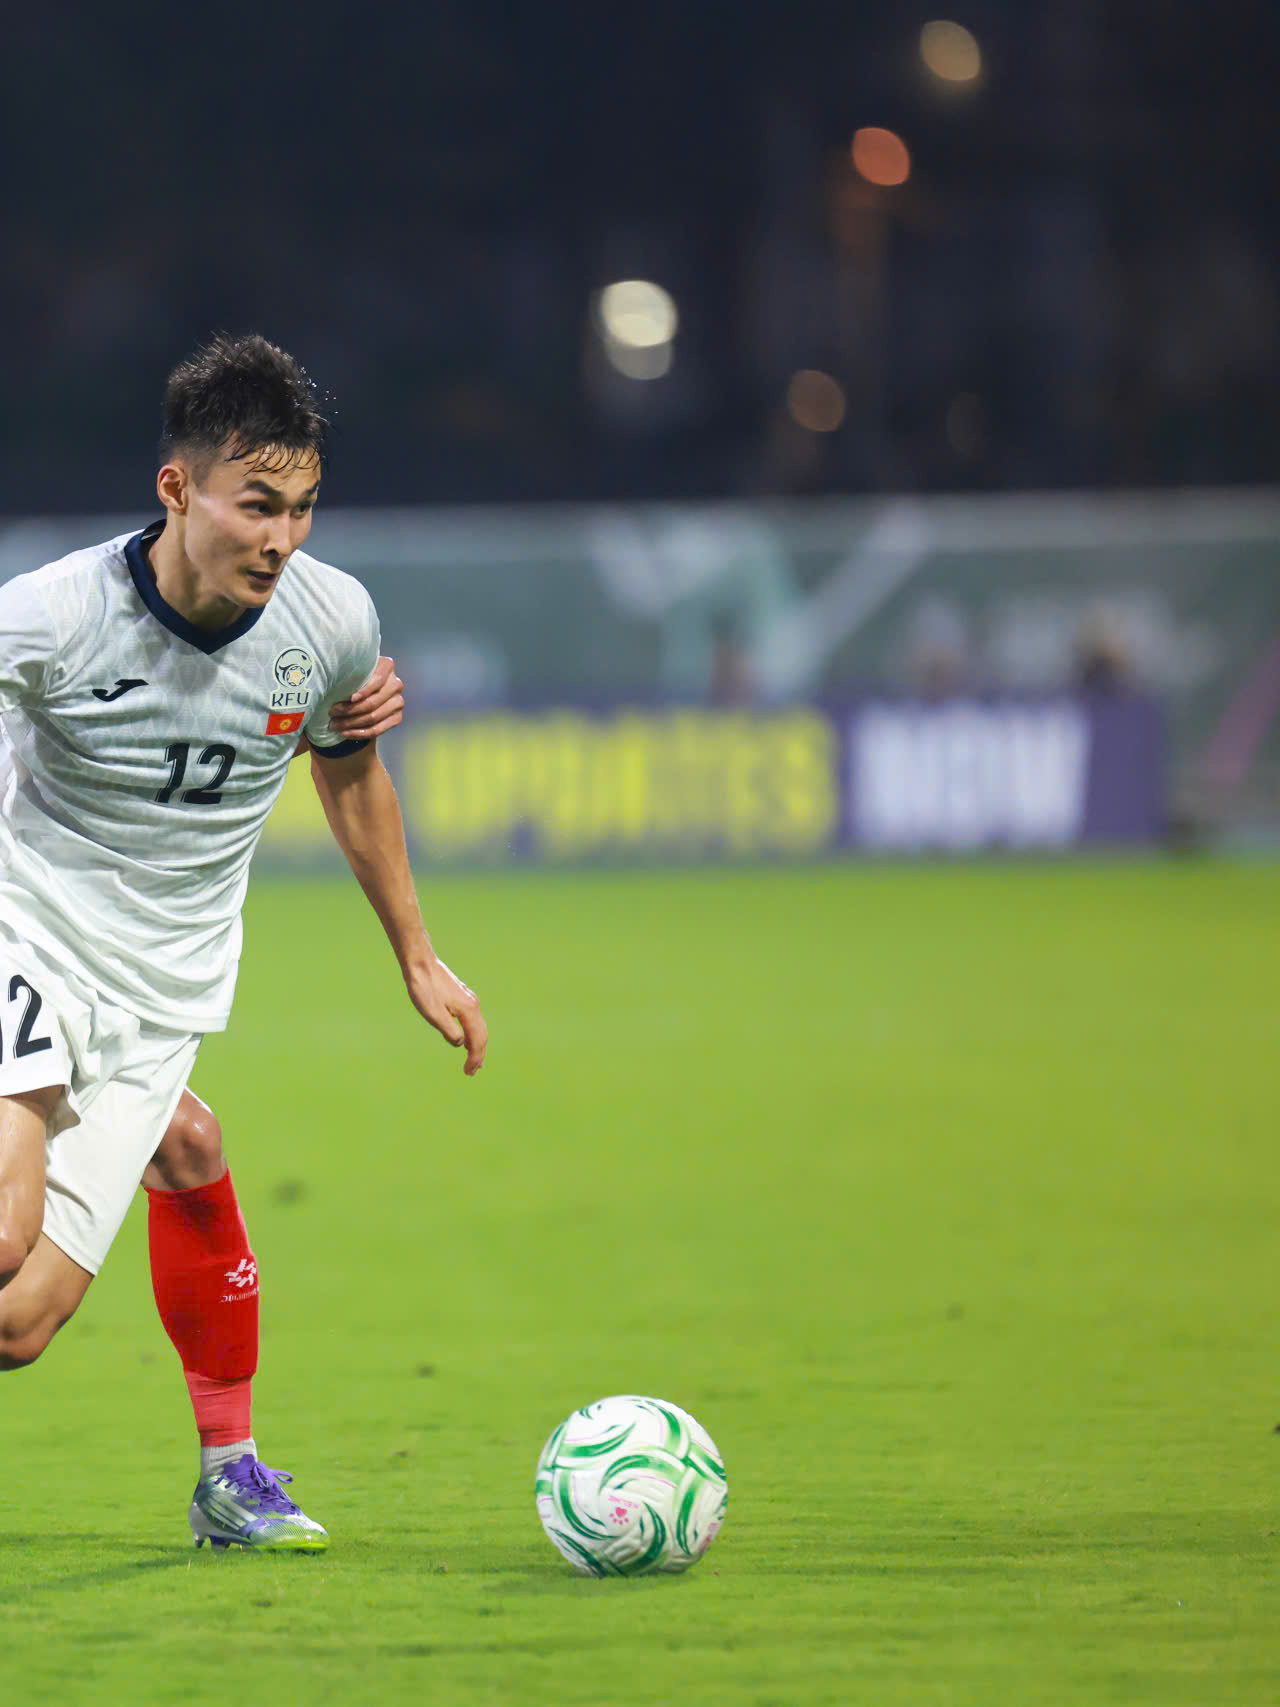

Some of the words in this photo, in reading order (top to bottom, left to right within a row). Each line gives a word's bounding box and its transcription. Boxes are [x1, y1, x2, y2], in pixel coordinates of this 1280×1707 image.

[271, 691, 310, 707] KFU
[154, 743, 237, 804] 12
[855, 700, 1091, 849] NOW
